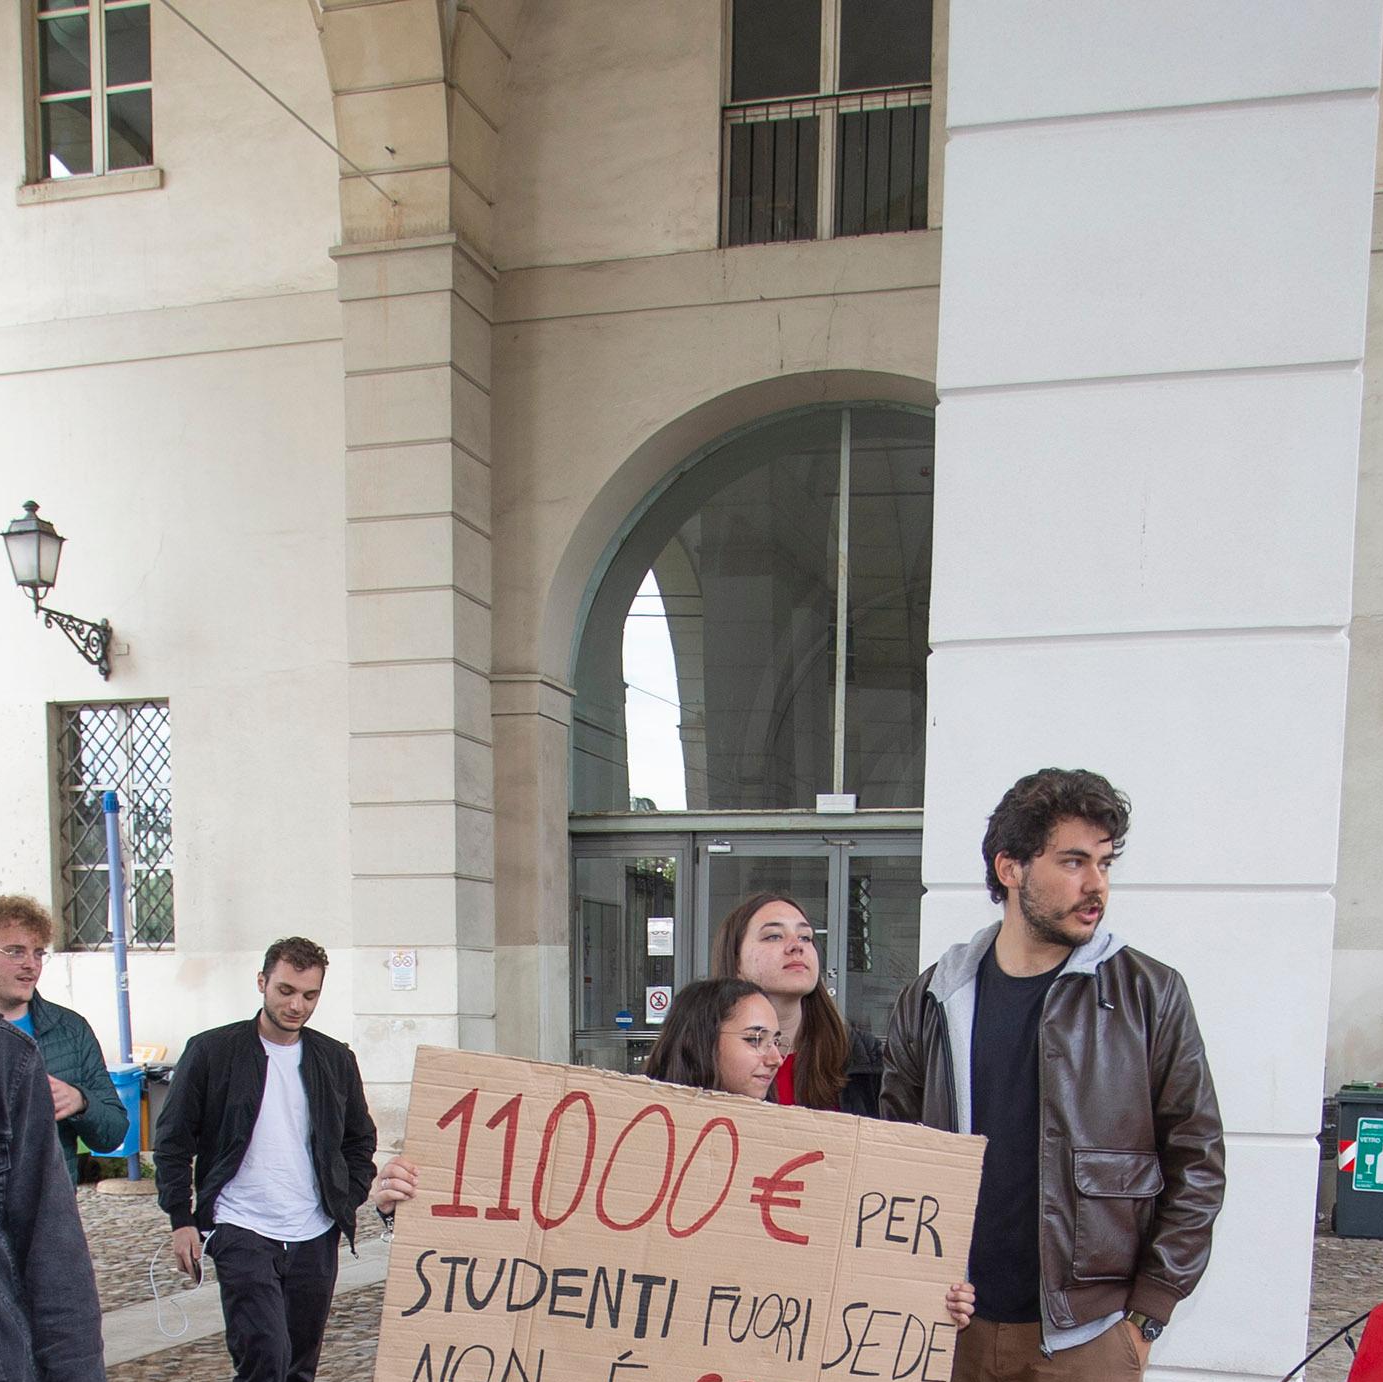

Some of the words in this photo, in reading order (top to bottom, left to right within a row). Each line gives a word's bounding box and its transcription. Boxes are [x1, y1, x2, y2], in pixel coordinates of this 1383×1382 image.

[430, 1087, 740, 1239] 11000
[855, 1191, 945, 1258] PER
[1359, 1136, 1381, 1144] VETRO
[401, 1248, 679, 1340] STUDENTI
[703, 1285, 812, 1363] FUORI
